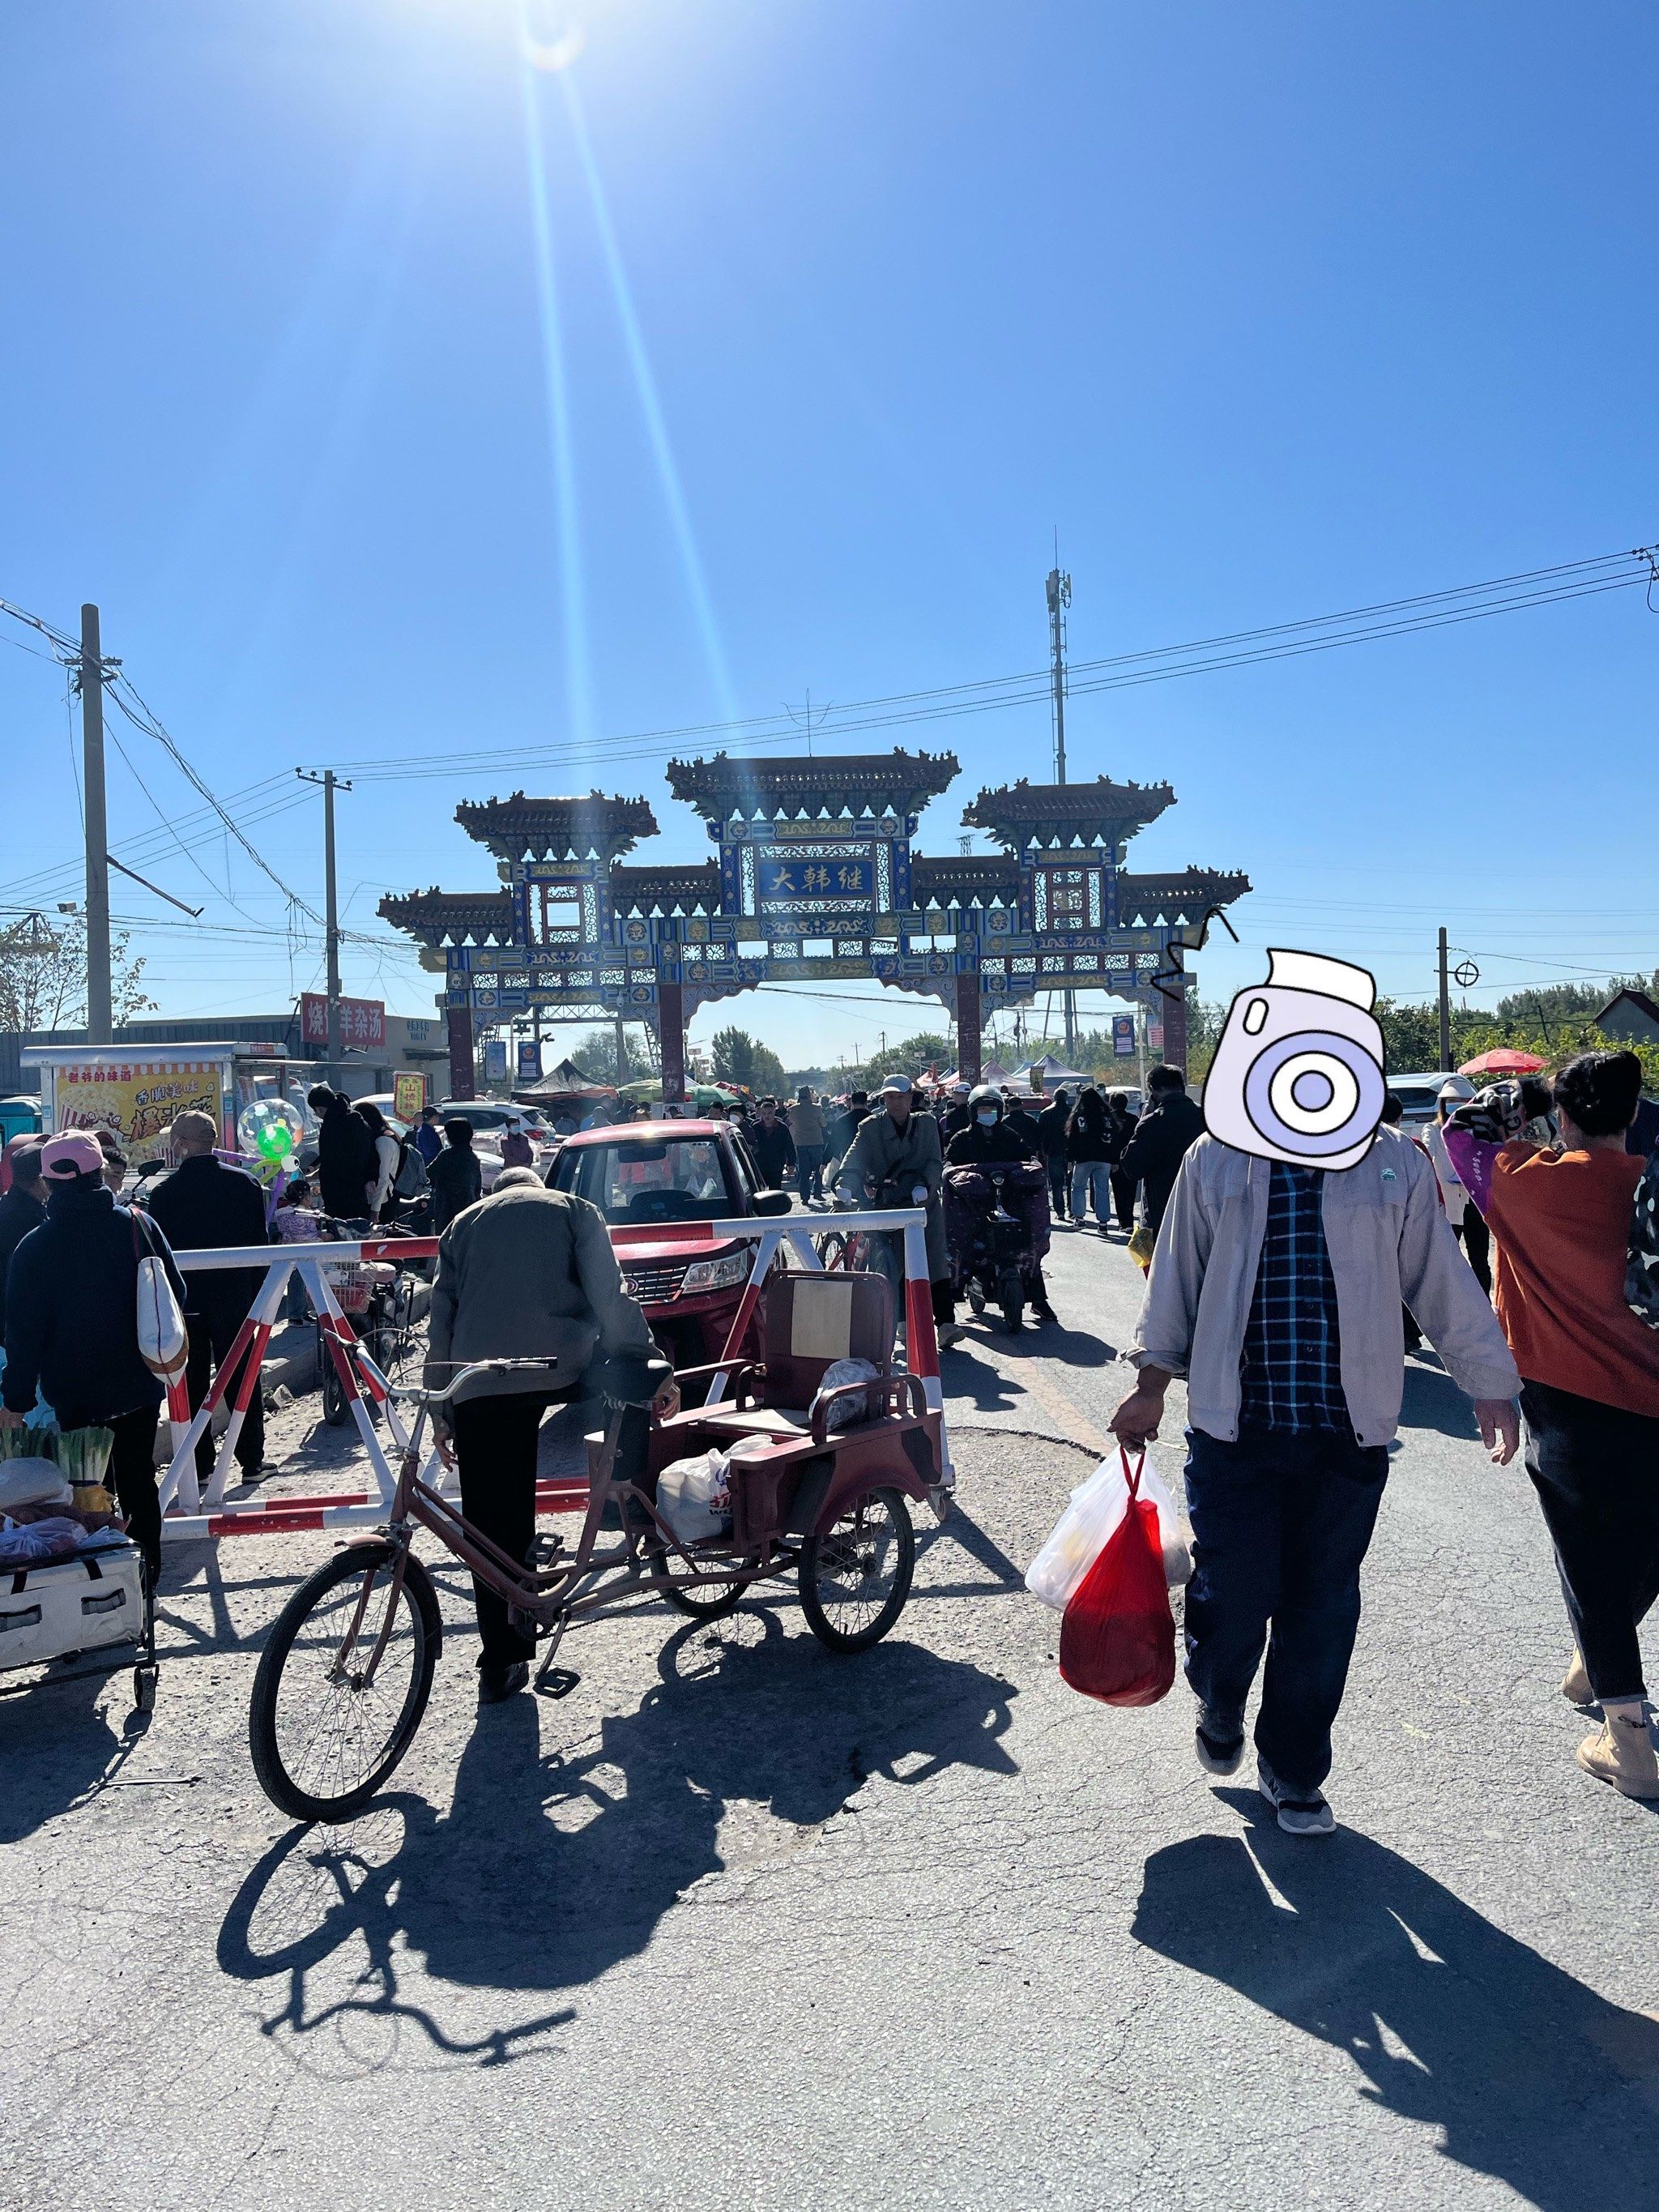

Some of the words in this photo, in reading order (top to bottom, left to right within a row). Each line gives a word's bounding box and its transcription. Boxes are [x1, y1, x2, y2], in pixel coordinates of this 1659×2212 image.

[769, 864, 864, 893] 大韩继
[135, 1079, 199, 1106] 香脆美味
